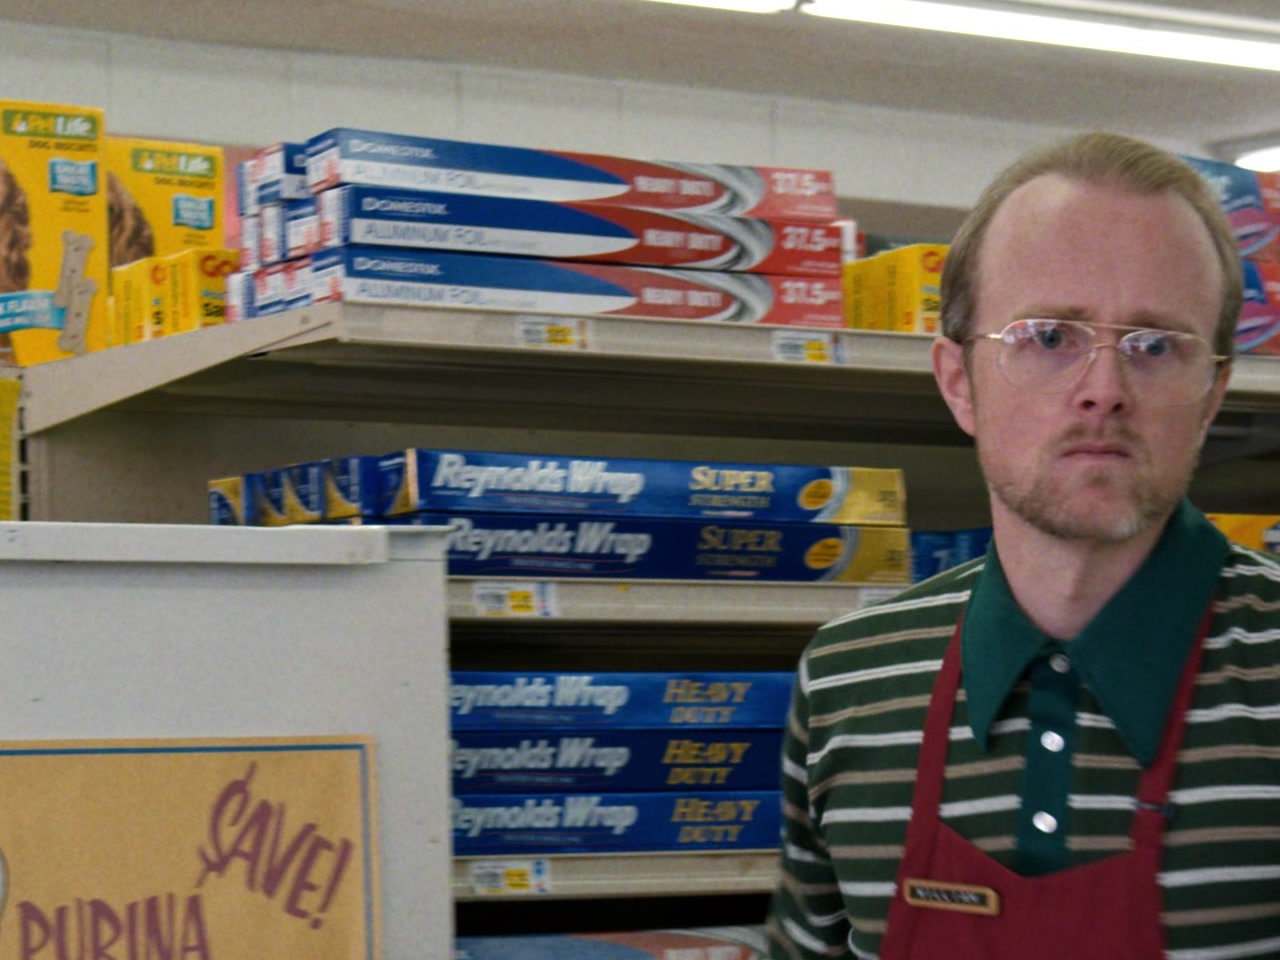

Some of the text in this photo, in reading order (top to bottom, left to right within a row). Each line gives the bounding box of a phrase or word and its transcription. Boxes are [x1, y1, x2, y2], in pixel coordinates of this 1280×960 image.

[431, 453, 645, 504] Reynolds Wrap
[690, 466, 775, 494] SUPER
[447, 518, 652, 565] Reynolds Wrap
[697, 525, 782, 553] SUPER
[451, 676, 631, 716] eynolds Wrap
[663, 680, 753, 704] HEAVY
[670, 706, 738, 725] DUTY
[556, 738, 631, 777] Wrap
[662, 740, 752, 764] HEAVY
[666, 767, 734, 785] DUTY
[562, 797, 639, 836] Wrap
[671, 798, 761, 823] HEAVY
[677, 825, 745, 844] DUTY
